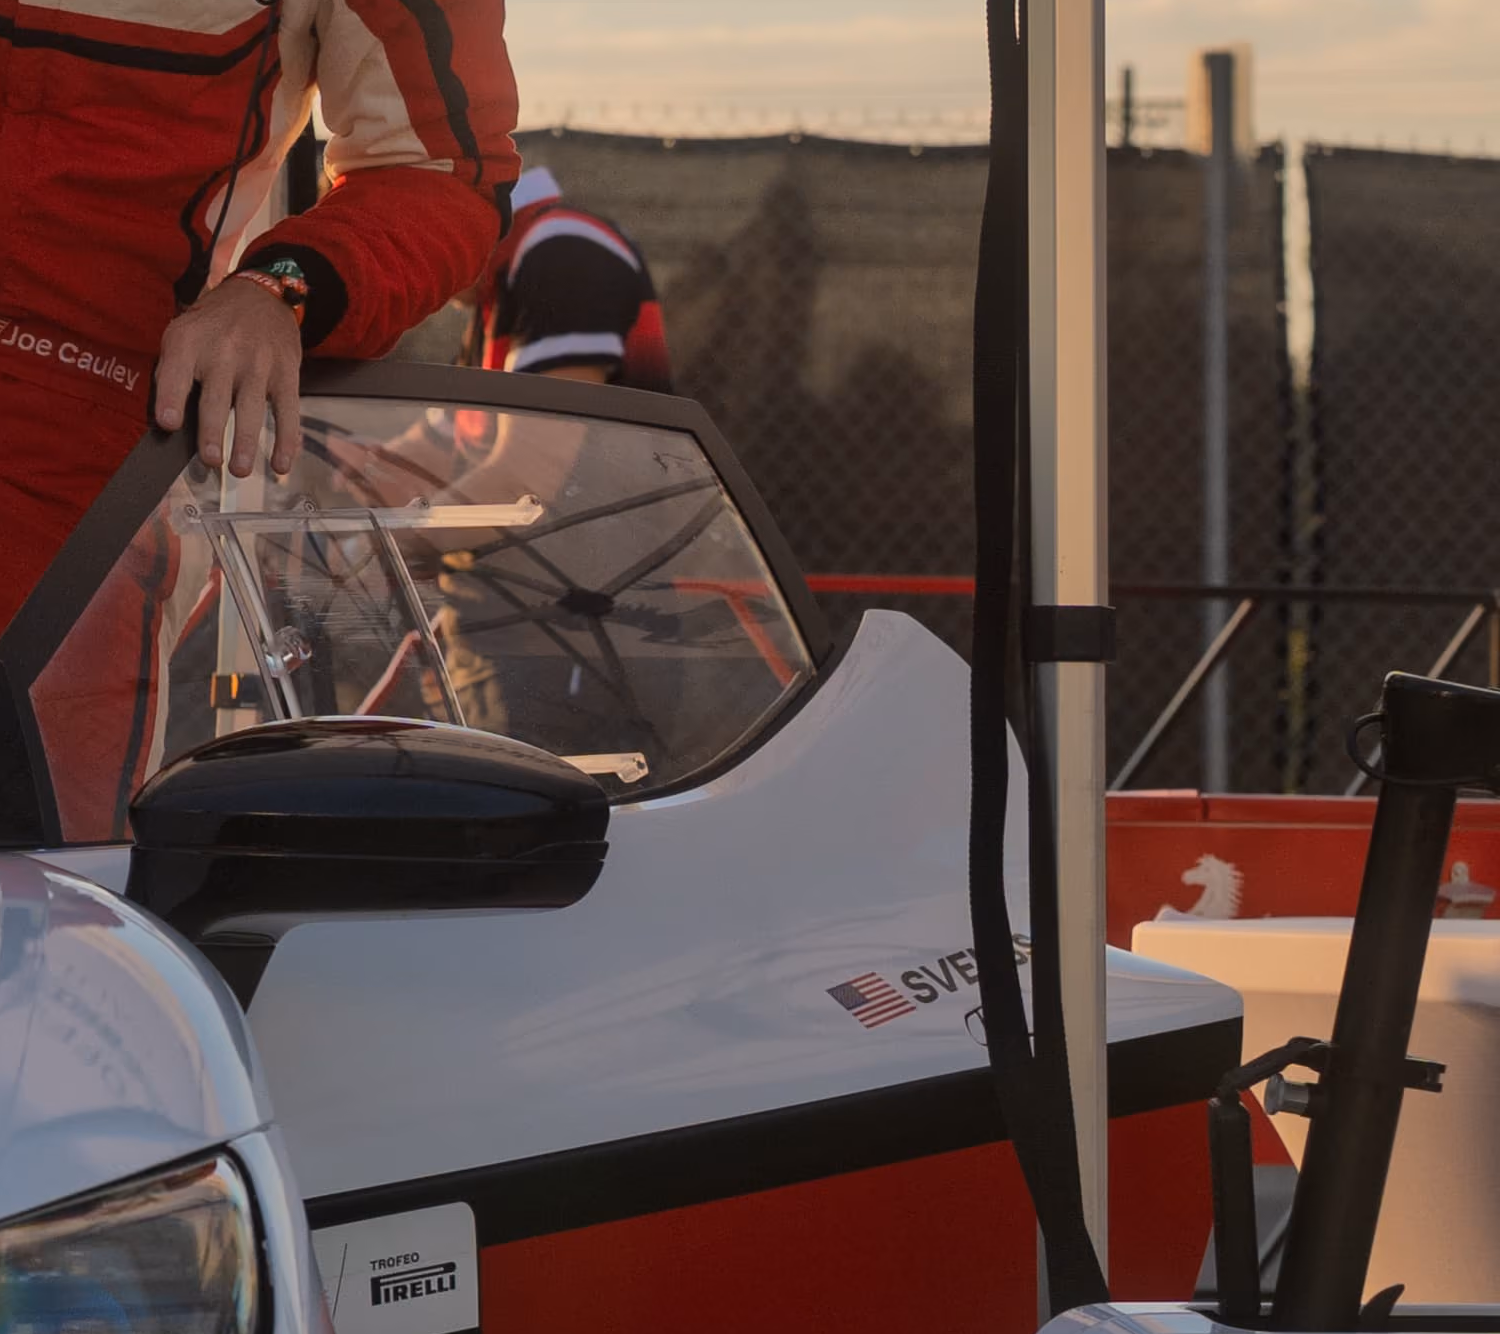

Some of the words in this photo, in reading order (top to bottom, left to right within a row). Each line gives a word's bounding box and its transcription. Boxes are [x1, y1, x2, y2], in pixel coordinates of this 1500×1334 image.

[0, 325, 53, 357] Joe
[57, 341, 141, 392] Cauley
[370, 1252, 420, 1271] TROFEO
[371, 1260, 457, 1307] PIRELLI
